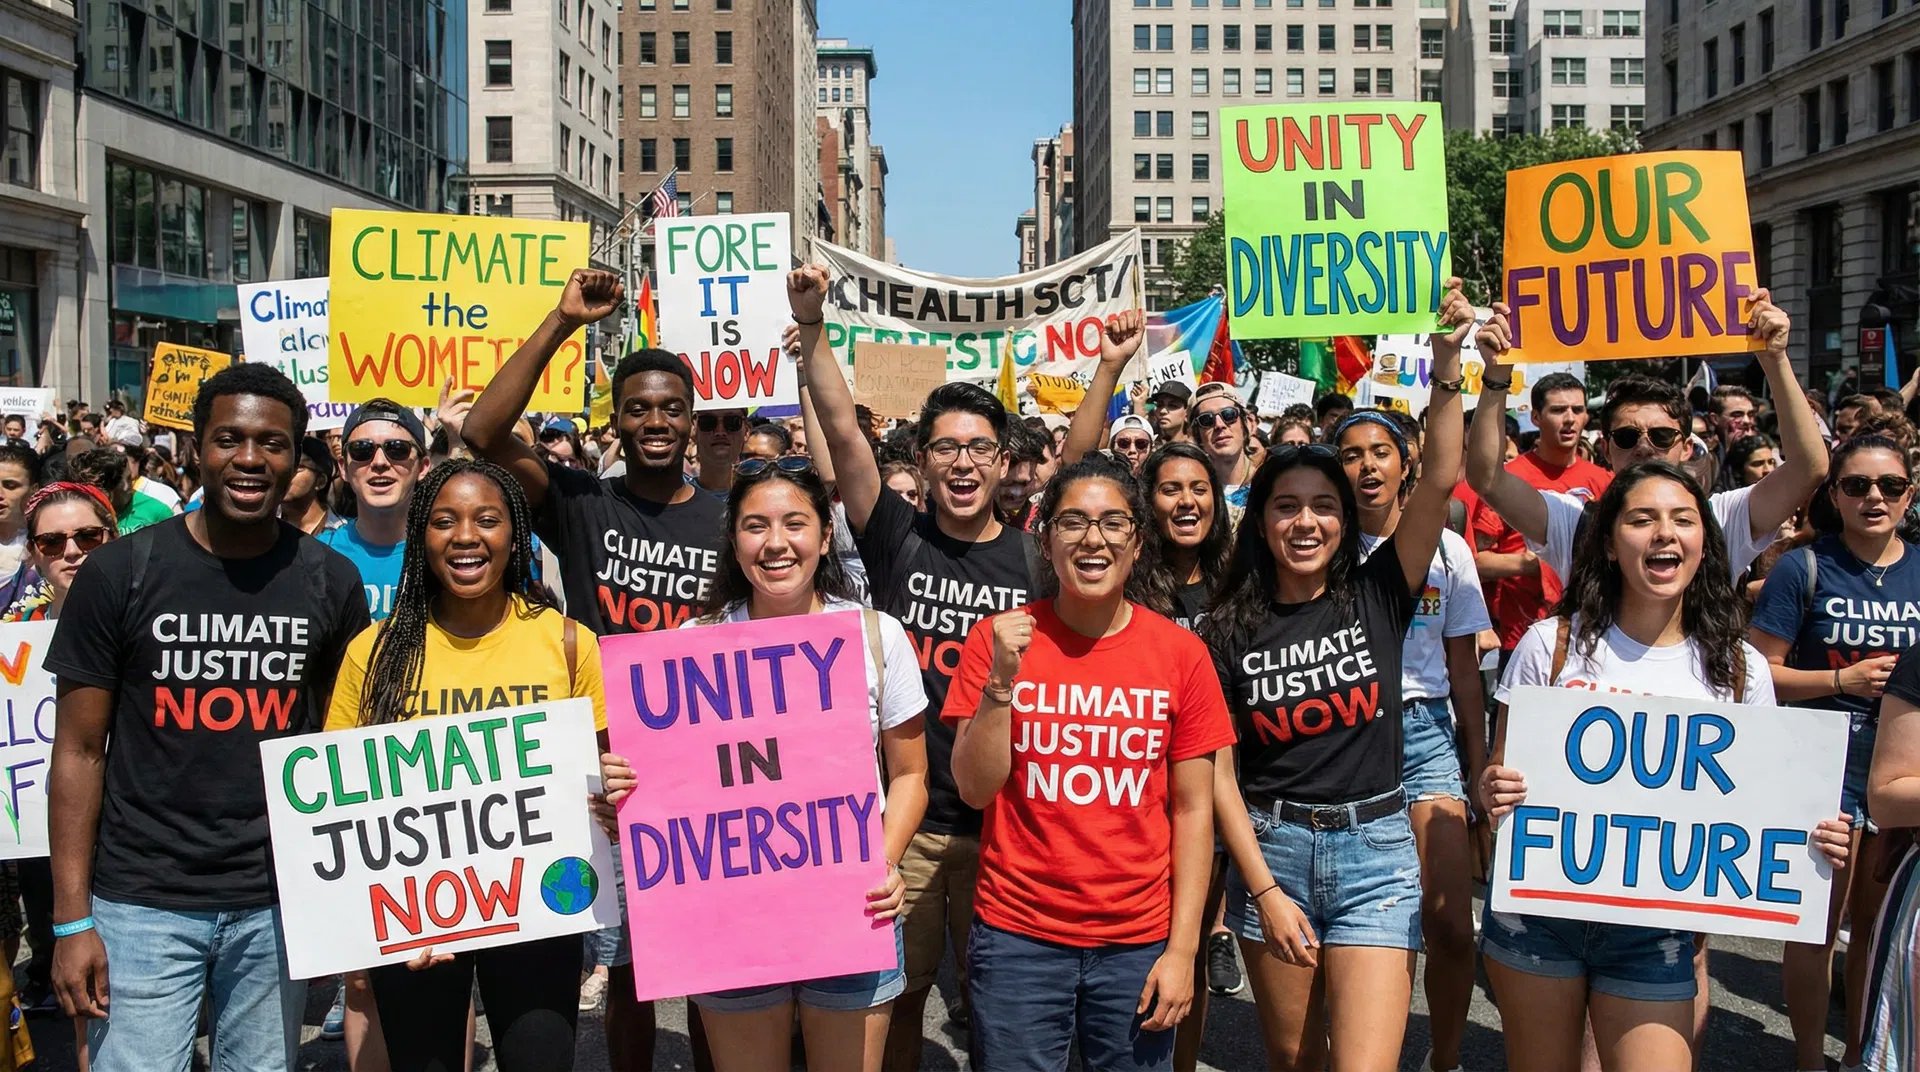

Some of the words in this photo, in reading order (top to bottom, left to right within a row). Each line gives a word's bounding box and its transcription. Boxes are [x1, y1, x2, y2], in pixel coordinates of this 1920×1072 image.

[1236, 113, 1428, 173] UNITY
[1303, 179, 1366, 221] IN
[1540, 161, 1710, 254] OUR
[351, 225, 567, 286] CLIMATE
[667, 221, 778, 274] FORE
[698, 275, 750, 317] IT
[1231, 230, 1448, 318] DIVERSITY
[1507, 251, 1752, 349] FUTURE
[422, 292, 488, 330] the
[711, 320, 742, 347] IS
[677, 347, 780, 400] NOW
[603, 529, 718, 572] CLIMATE
[596, 558, 713, 601] JUSTICE
[908, 571, 1027, 611] CLIMATE
[152, 613, 309, 645] CLIMATE
[901, 600, 984, 637] JUST
[1823, 622, 1918, 648] JUSTI
[1825, 597, 1920, 621] CLIMA
[152, 649, 307, 681] JUSTICE
[1242, 619, 1366, 675] CLIMATE
[629, 637, 845, 730] UNITY
[1011, 681, 1170, 721] CLIMATE
[1247, 649, 1378, 706] JUSTICE
[154, 685, 298, 731] NOW
[1251, 681, 1379, 745] NOW
[282, 711, 553, 814] CLIMATE
[716, 737, 783, 788] IN
[1014, 720, 1164, 760] JUSTICE
[1565, 705, 1736, 796] OUR
[1027, 761, 1150, 807] NOW
[311, 786, 553, 881] JUSTICE
[629, 791, 877, 891] DIVERSITY
[1508, 805, 1808, 905] FUTURE
[368, 857, 525, 942] NOW
